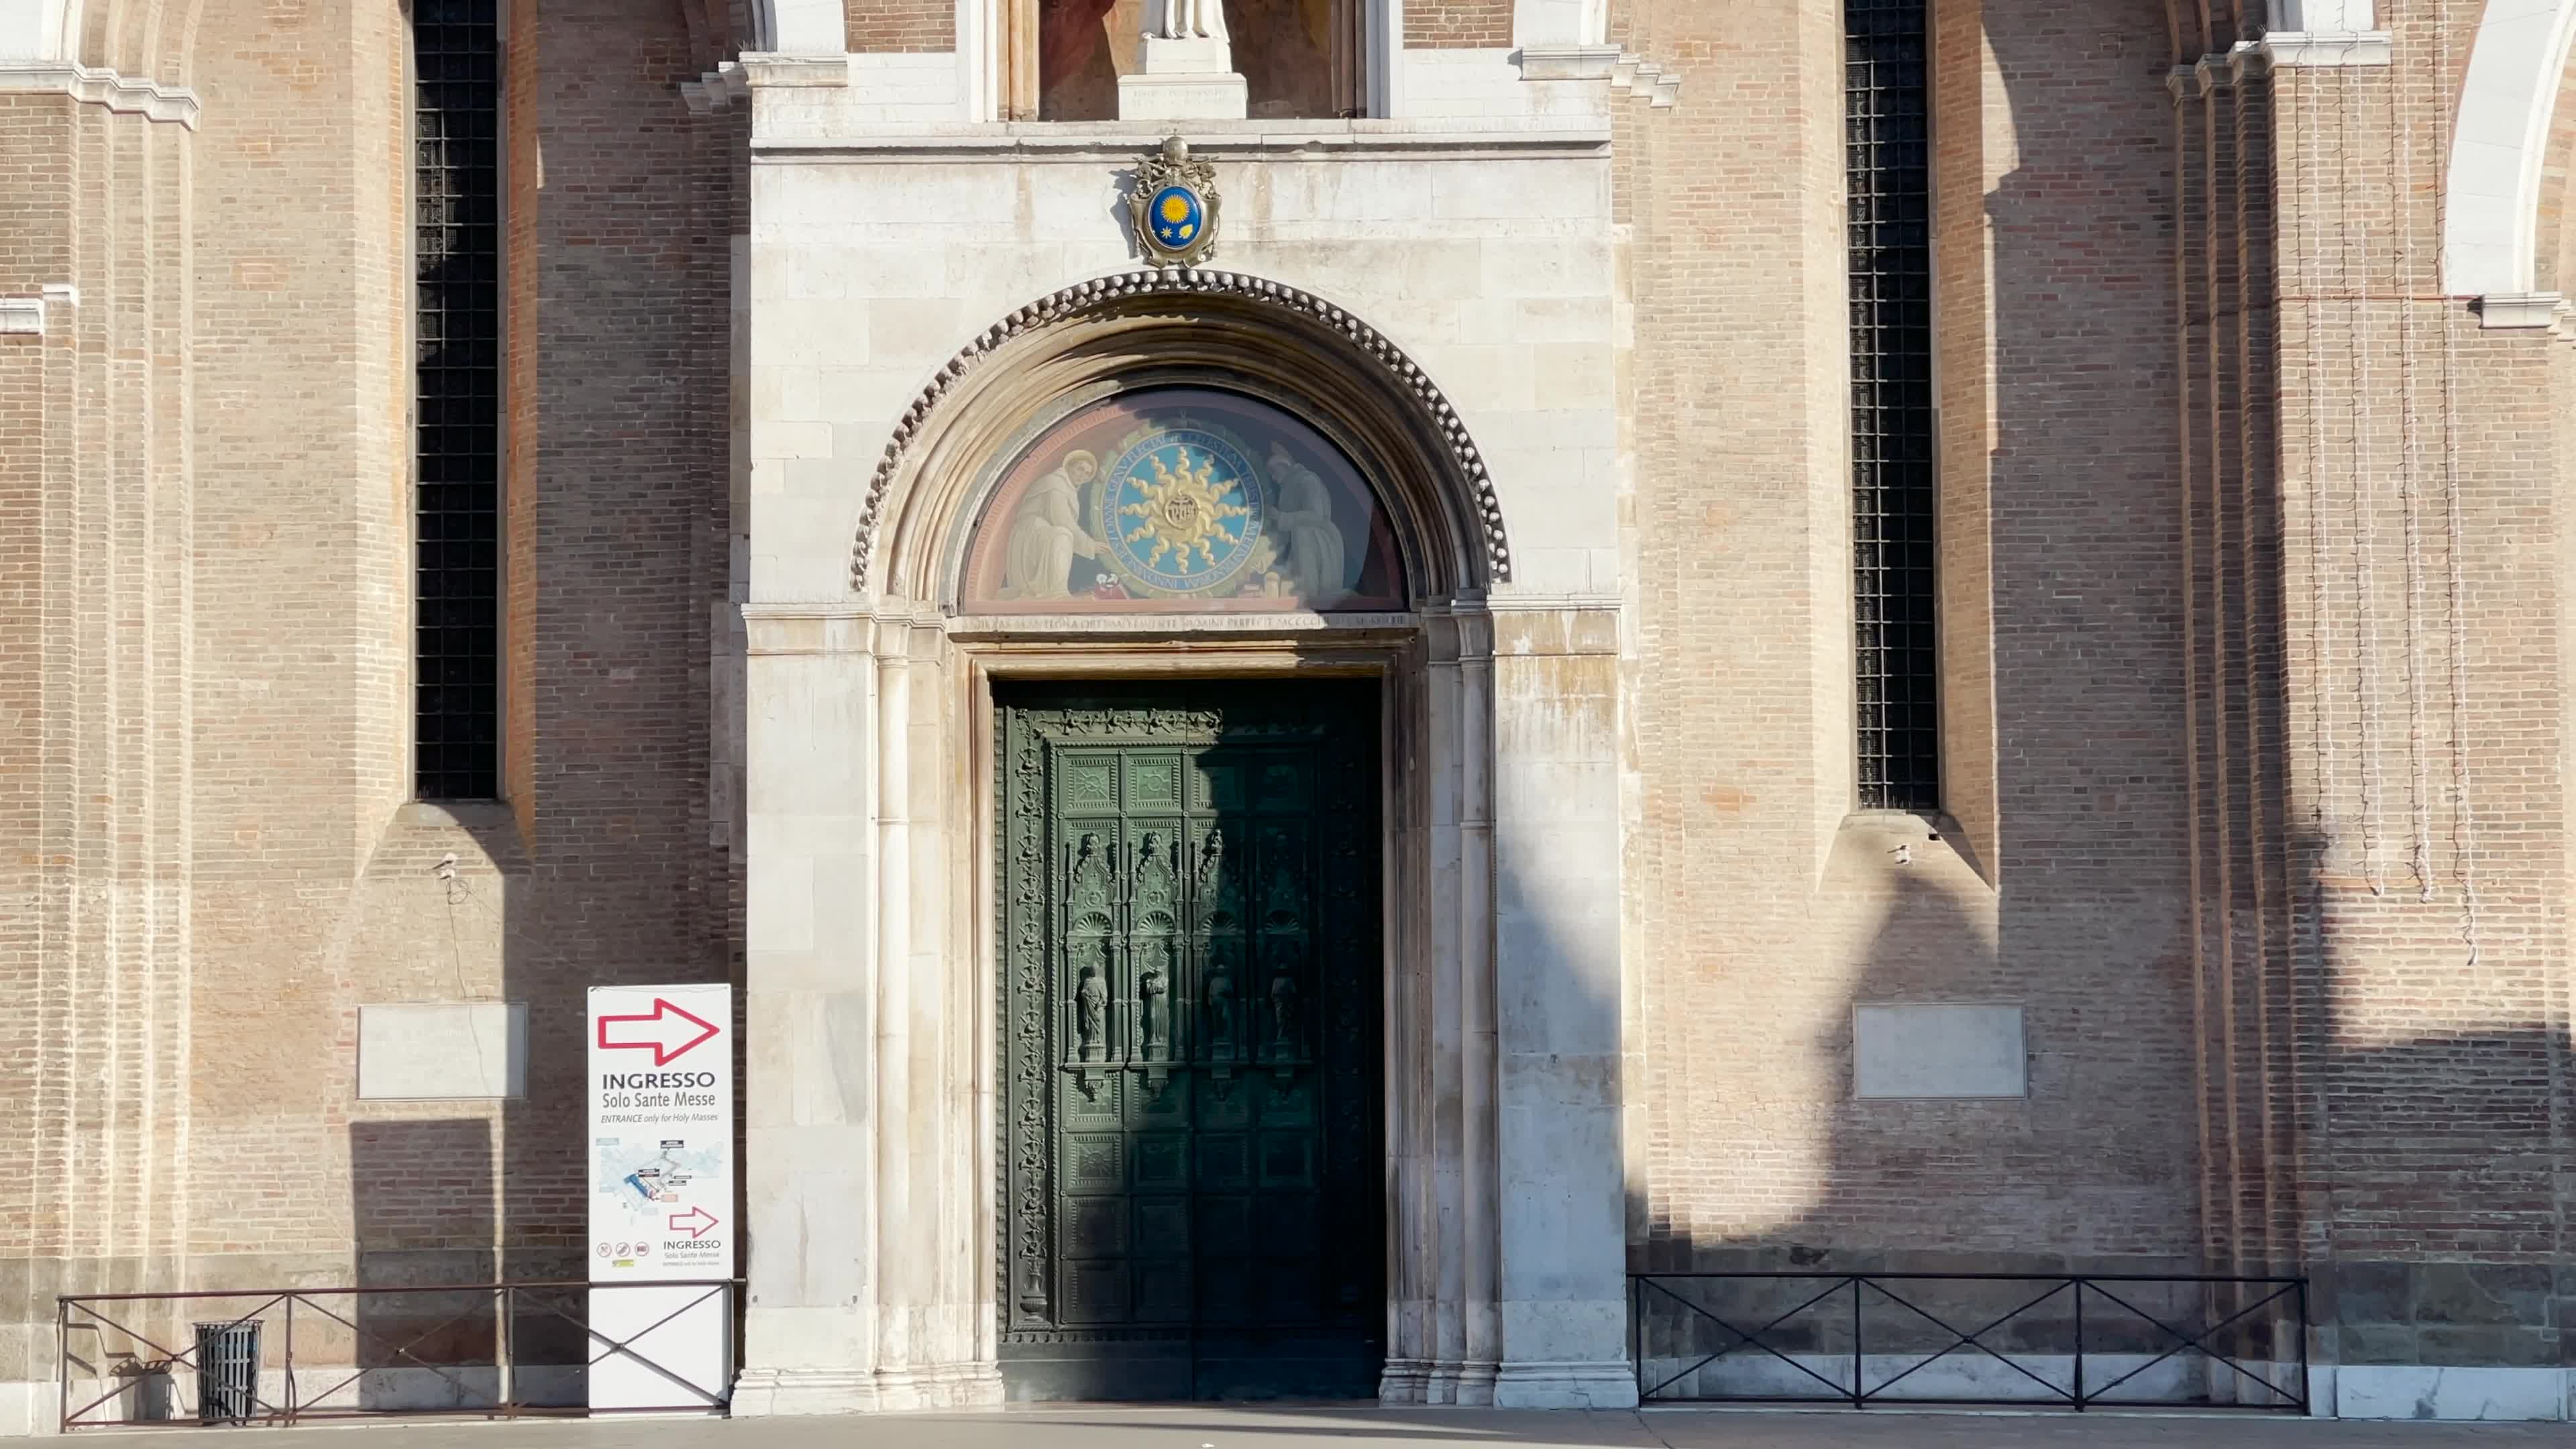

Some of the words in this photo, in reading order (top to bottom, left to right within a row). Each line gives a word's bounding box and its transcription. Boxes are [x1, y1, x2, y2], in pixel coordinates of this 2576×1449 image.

[602, 1072, 716, 1089] INGRESSO
[602, 1092, 631, 1108] Solo
[635, 1092, 670, 1108] Sante
[674, 1091, 716, 1106] Messe
[601, 1114, 643, 1124] ENTRANCE
[644, 1114, 659, 1124] only
[661, 1114, 672, 1123] for
[673, 1114, 690, 1124] Holy
[692, 1113, 718, 1122] Masses
[663, 1240, 721, 1250] INGRESSO
